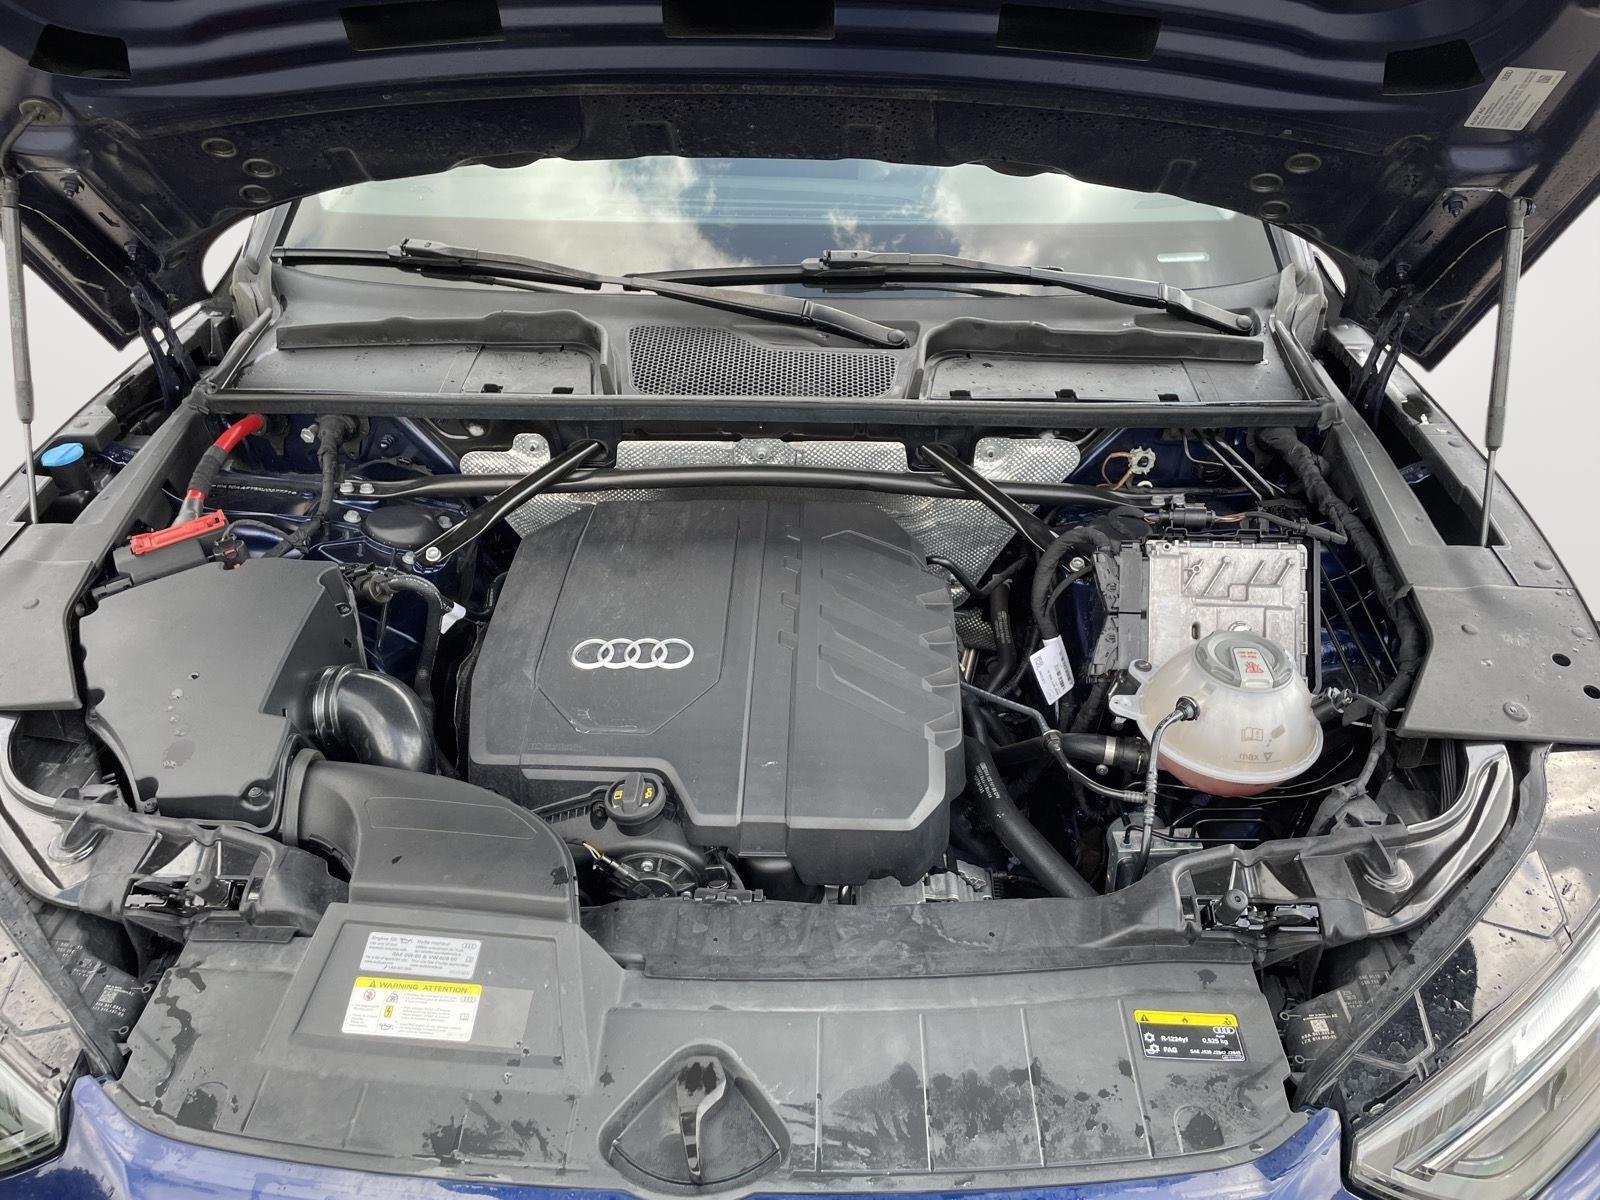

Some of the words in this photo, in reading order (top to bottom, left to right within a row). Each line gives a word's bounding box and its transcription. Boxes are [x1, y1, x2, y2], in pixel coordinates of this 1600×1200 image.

[1239, 752, 1260, 761] max
[379, 981, 419, 991] WARNING
[421, 984, 468, 994] ATTENTION
